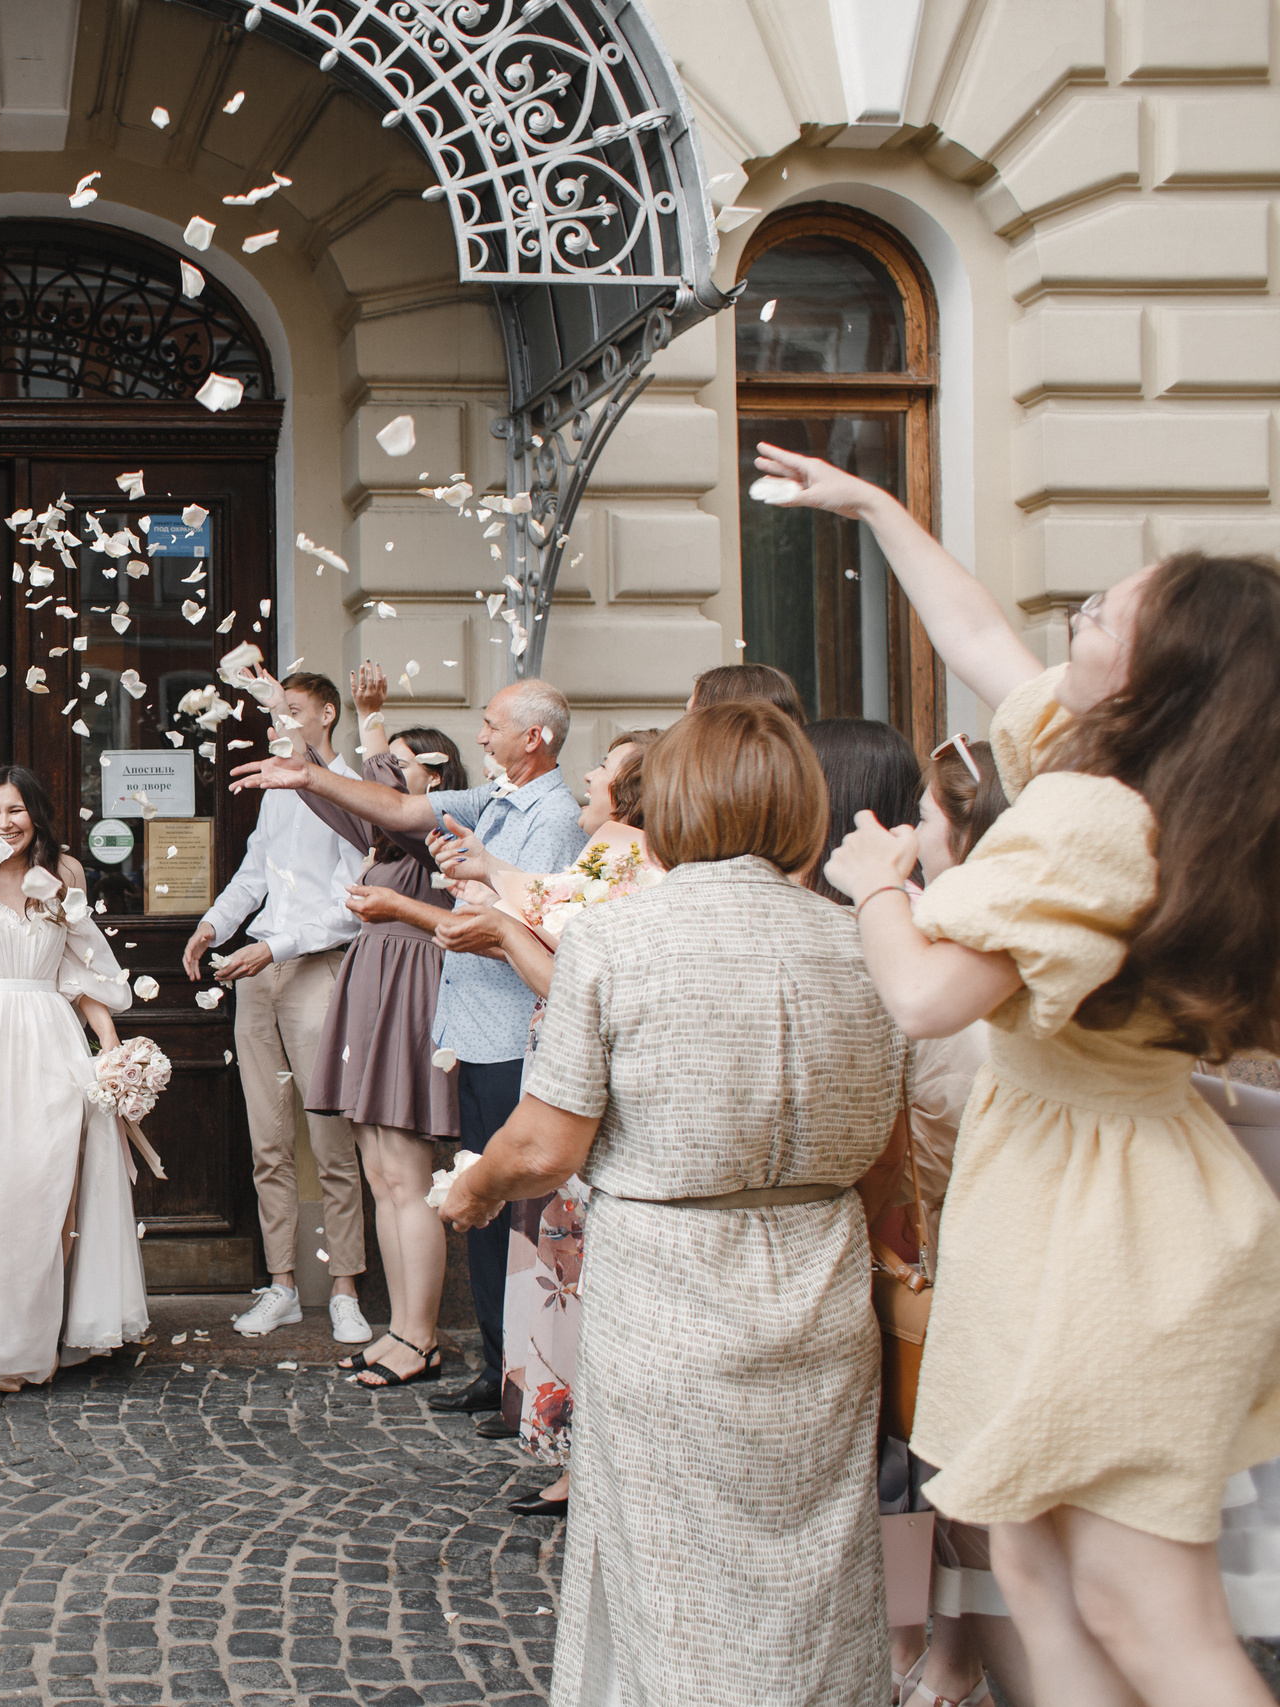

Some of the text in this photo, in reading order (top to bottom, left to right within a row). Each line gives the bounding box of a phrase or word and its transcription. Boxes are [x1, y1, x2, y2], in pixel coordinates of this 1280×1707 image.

[122, 765, 175, 774] Апостиль
[126, 782, 172, 793] во дворе
